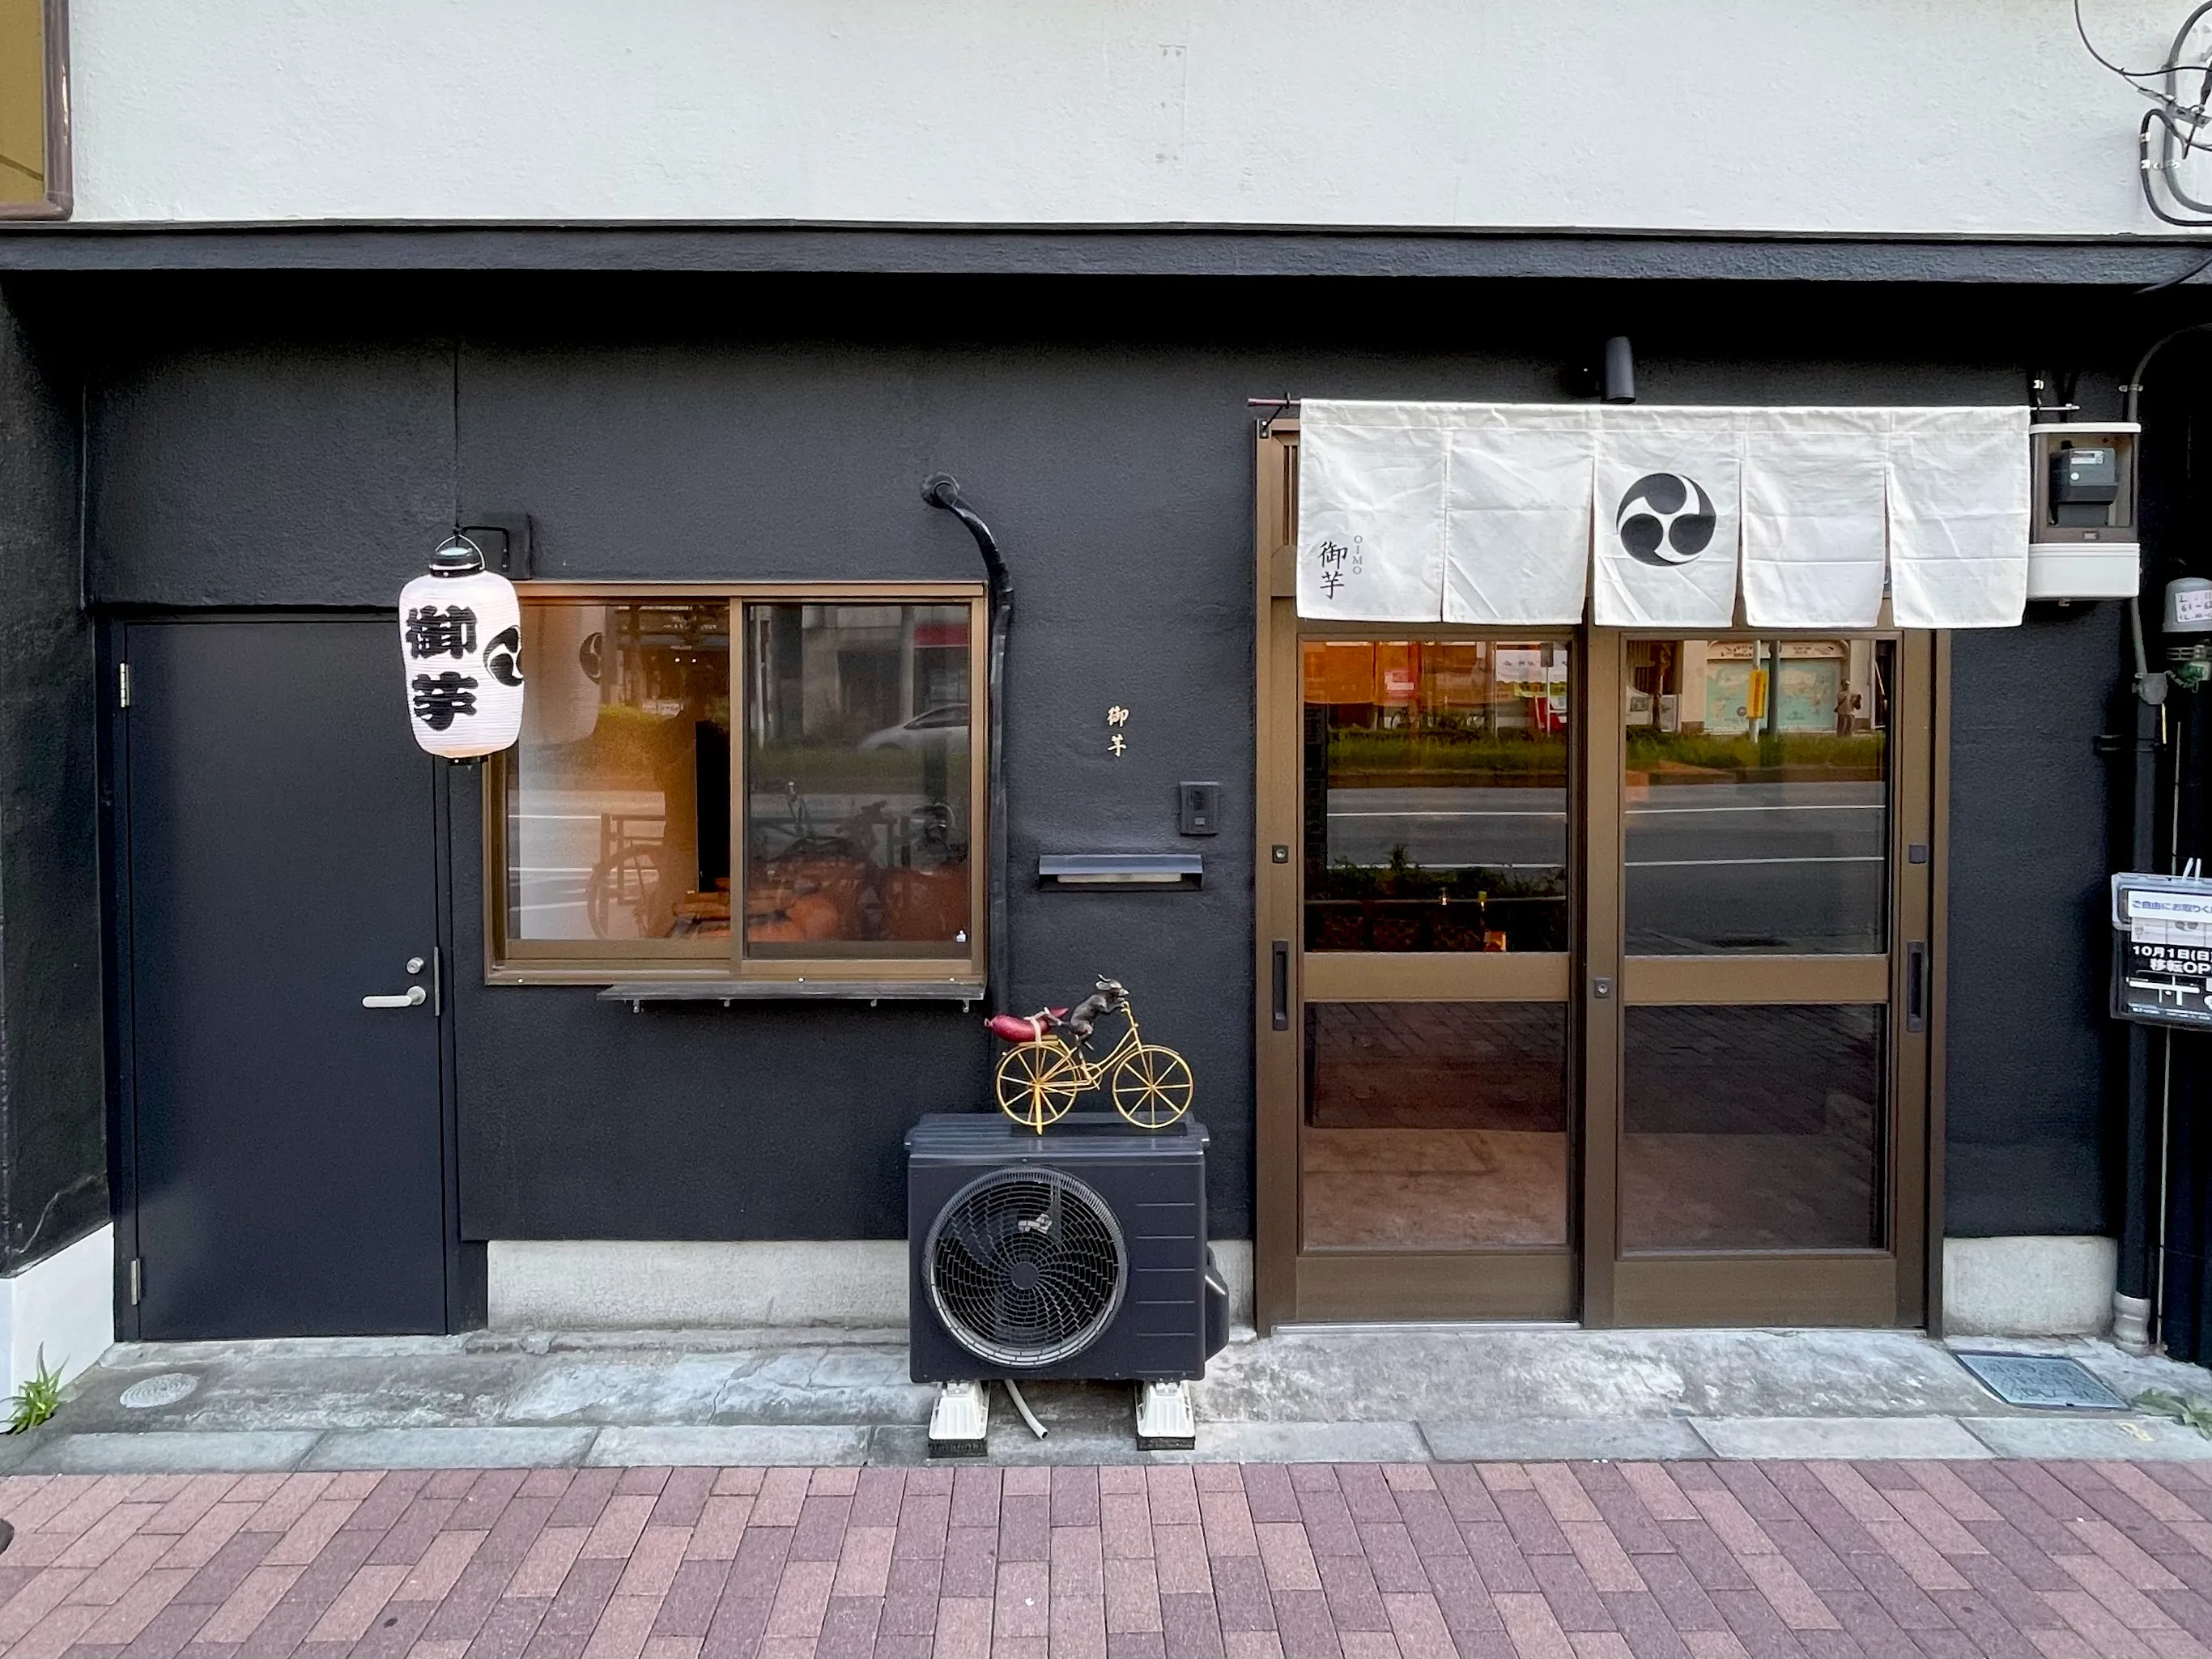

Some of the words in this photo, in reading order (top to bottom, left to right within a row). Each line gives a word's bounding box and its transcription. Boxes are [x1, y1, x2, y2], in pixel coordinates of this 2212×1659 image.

[1317, 540, 1348, 600] 御芋
[1352, 534, 1363, 575] OIMO
[406, 605, 479, 730] 御芋
[1107, 705, 1129, 757] 御芋
[2132, 900, 2212, 914] ご自由にお取りく
